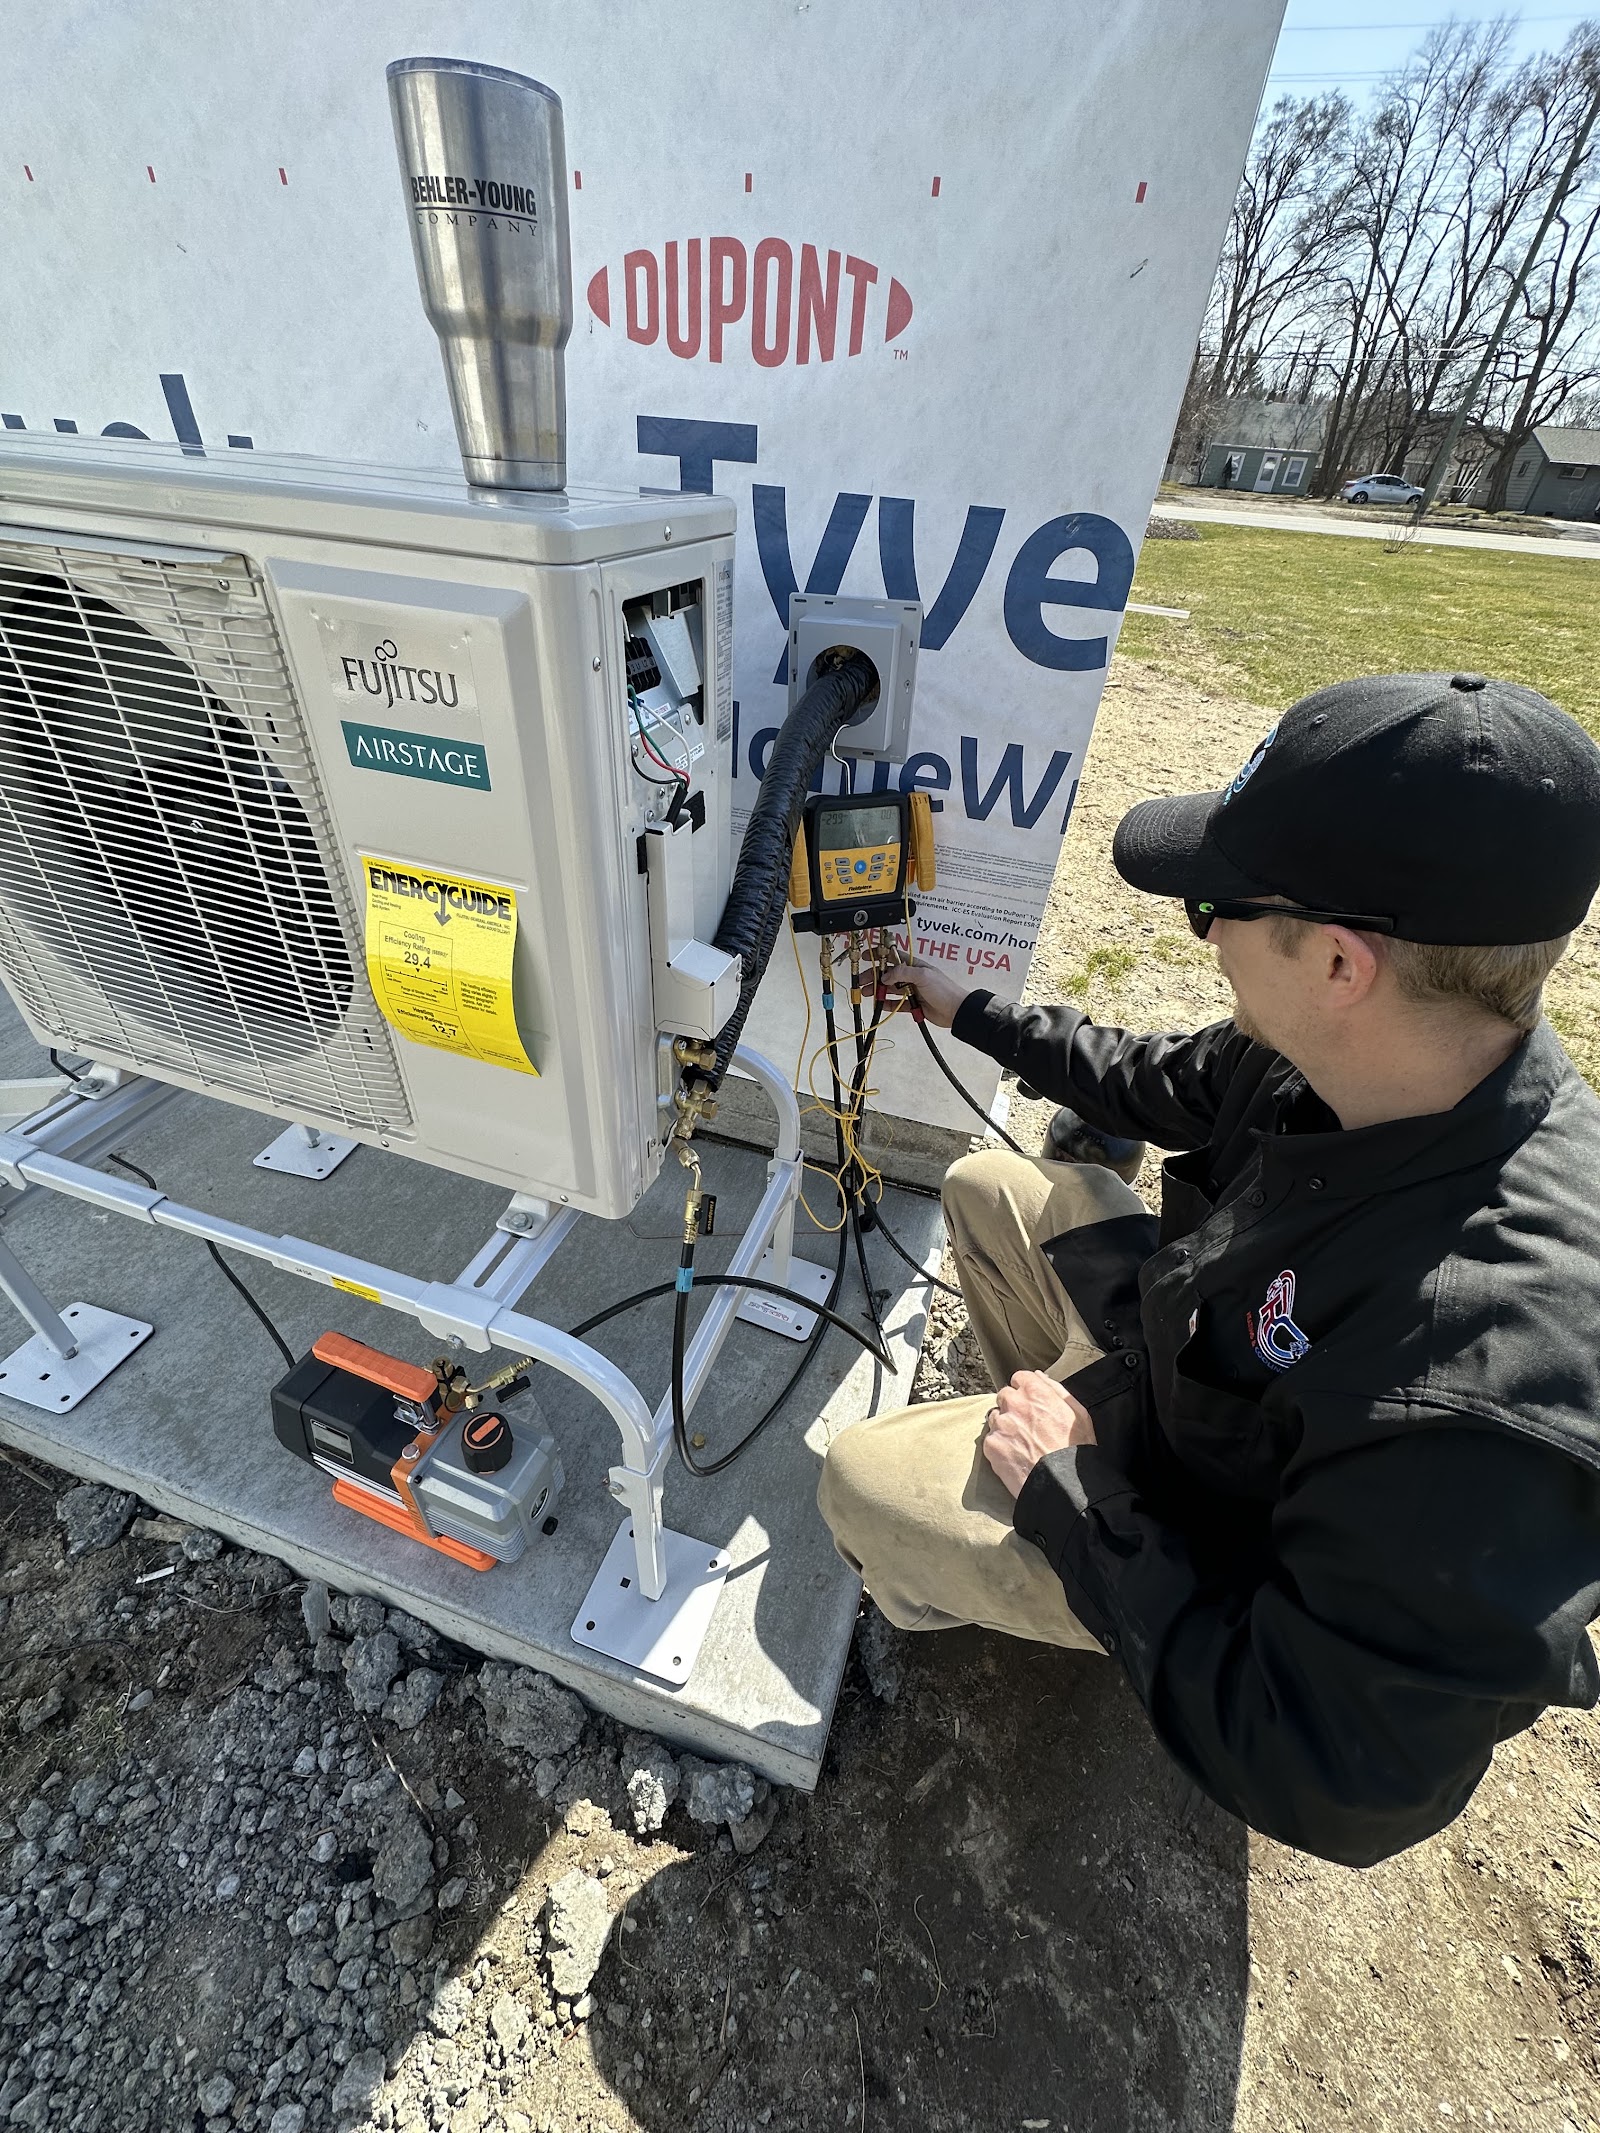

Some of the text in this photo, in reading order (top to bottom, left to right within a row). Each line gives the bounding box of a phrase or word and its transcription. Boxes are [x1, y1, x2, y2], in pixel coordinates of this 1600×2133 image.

[411, 176, 537, 216] BEHLER-YOUNG
[417, 212, 537, 237] COMPANY
[624, 237, 878, 368] DUPONT
[341, 656, 459, 708] FUJITSU
[356, 735, 481, 779] AIRSTAGE
[369, 867, 512, 921] ENERGYGUIDE
[946, 899, 966, 907] barrier
[967, 903, 995, 913] according
[971, 910, 1002, 922] Evaluation
[1003, 916, 1023, 925] Report
[384, 935, 412, 949] Efficiency
[404, 931, 426, 944] Cooling
[404, 951, 431, 968] 29.4
[916, 937, 960, 962] THE
[966, 947, 1011, 972] USA
